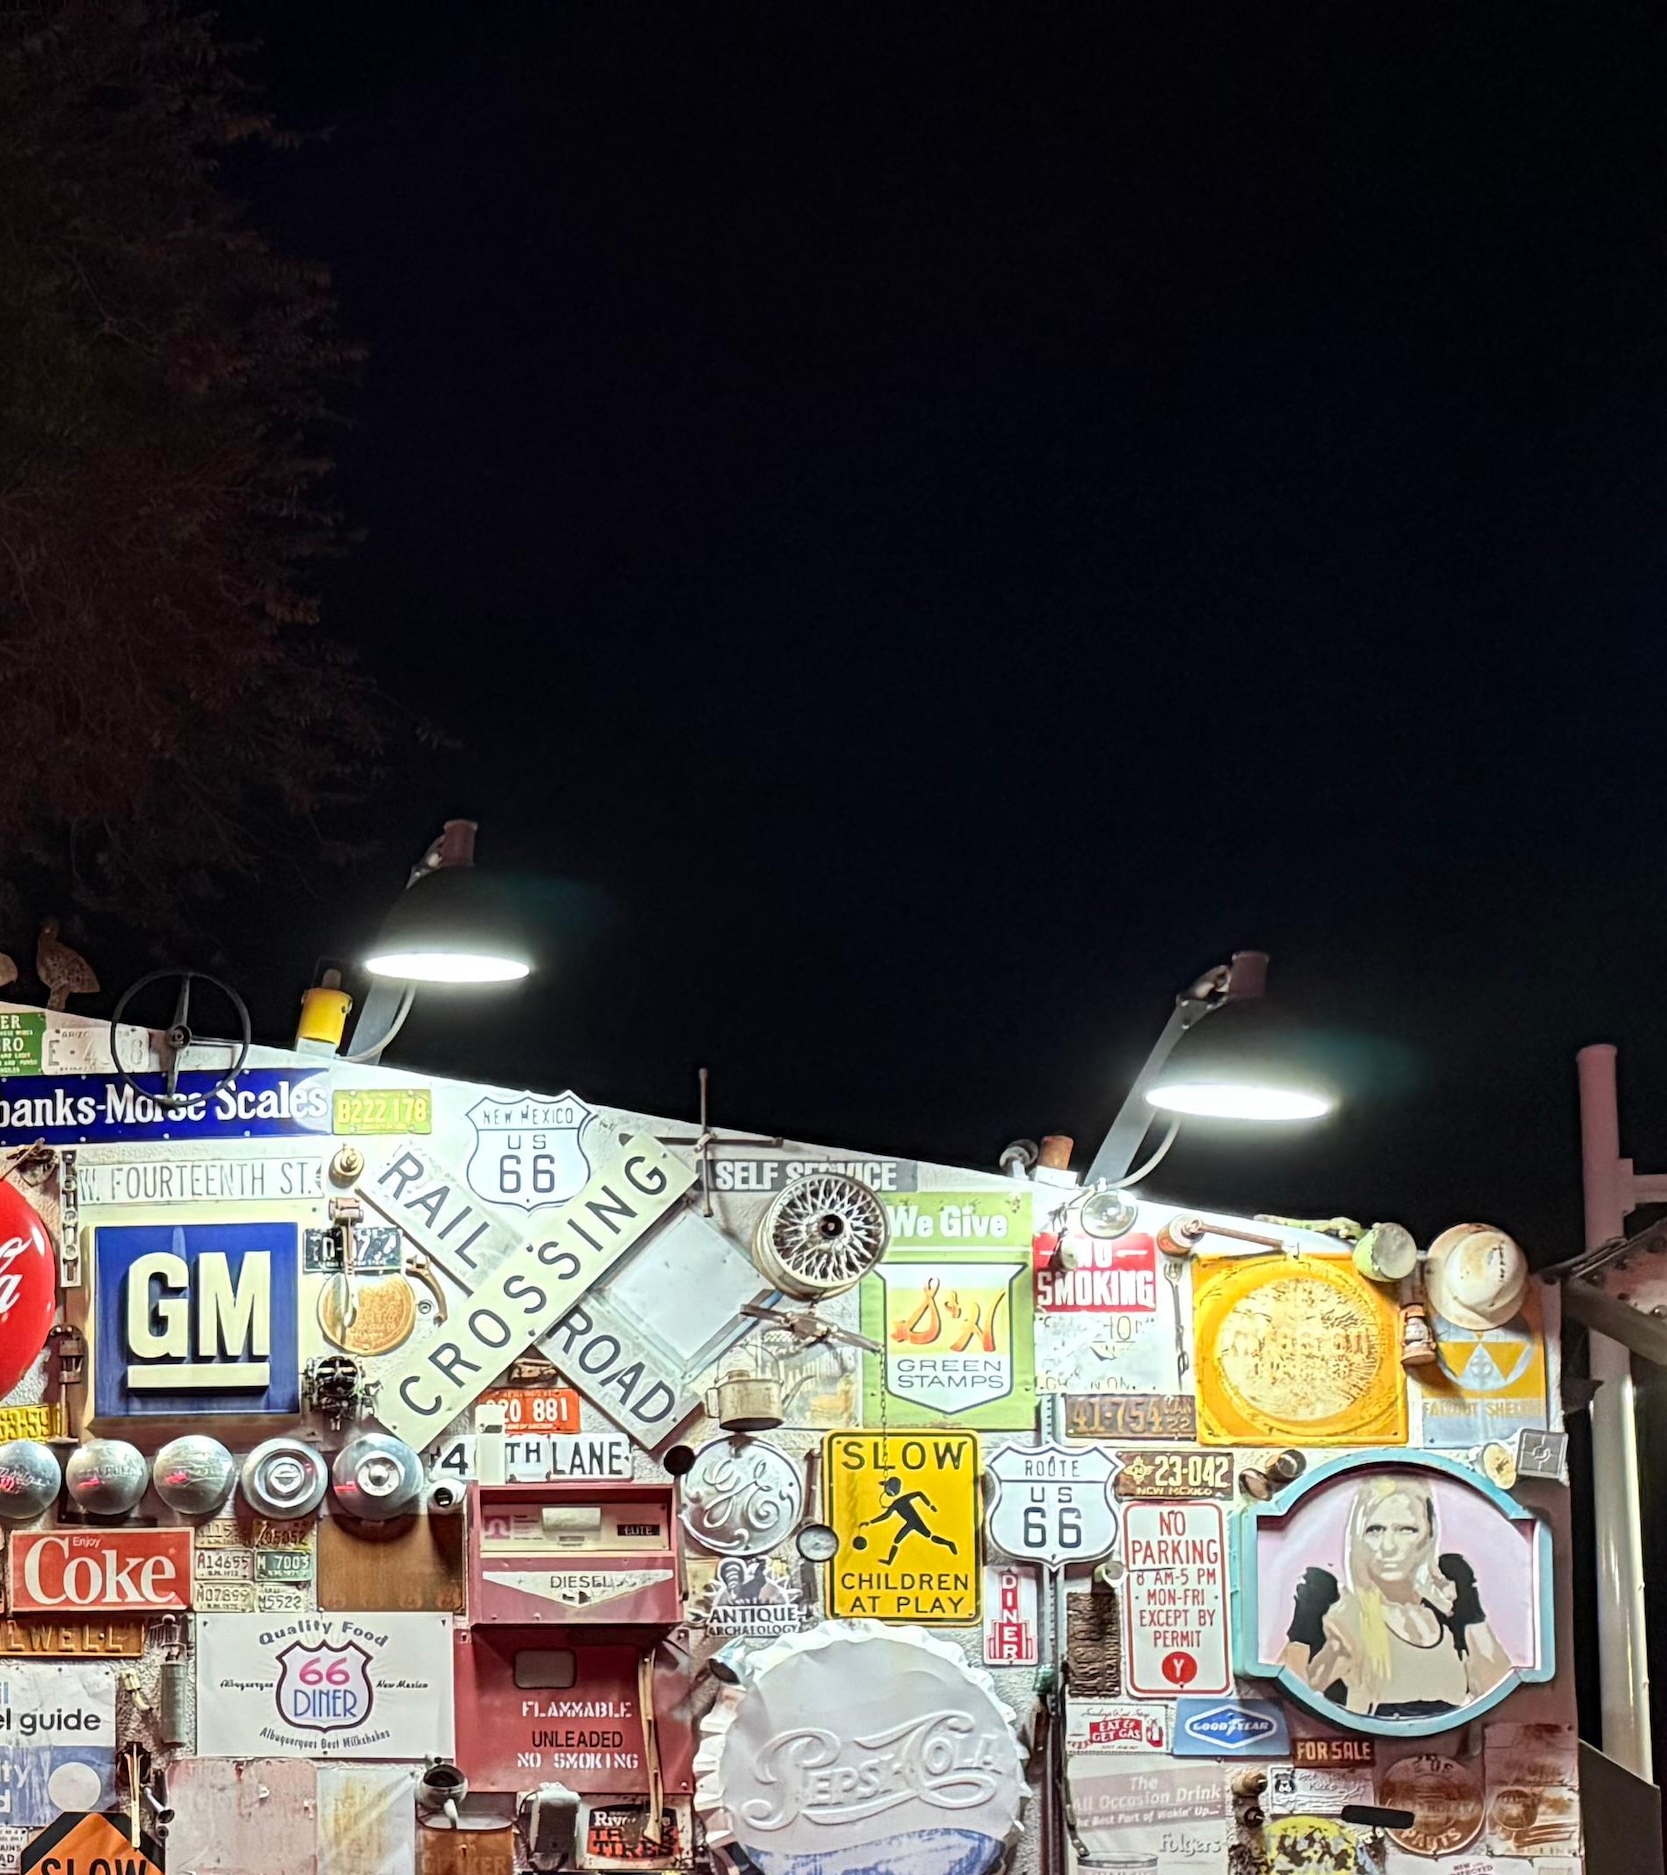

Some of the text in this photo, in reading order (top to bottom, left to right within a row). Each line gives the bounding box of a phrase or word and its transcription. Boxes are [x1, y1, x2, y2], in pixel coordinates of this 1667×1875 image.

[887, 1204, 1008, 1238] We Give
[378, 1152, 675, 1424] RAIL ROAD
[399, 1155, 666, 1417] CROSSING
[128, 1250, 271, 1358] GM
[897, 1359, 1002, 1375] GREEN
[897, 1374, 1005, 1389] STAMPS
[842, 1441, 967, 1471] SLOW
[1159, 1511, 1186, 1537] NO
[73, 1536, 101, 1549] Enjoy
[1131, 1539, 1218, 1565] PARKING
[24, 1536, 176, 1606] Coke
[1154, 1569, 1189, 1586] AM-5
[1197, 1568, 1217, 1585] PM
[841, 1573, 969, 1592] CHILDREN
[850, 1597, 965, 1615] AT PLAY
[1147, 1589, 1205, 1606] MON-FRI
[1139, 1609, 1216, 1627] EXCEPT BY
[1154, 1631, 1202, 1648] PERMIT
[20, 1708, 101, 1735] guide
